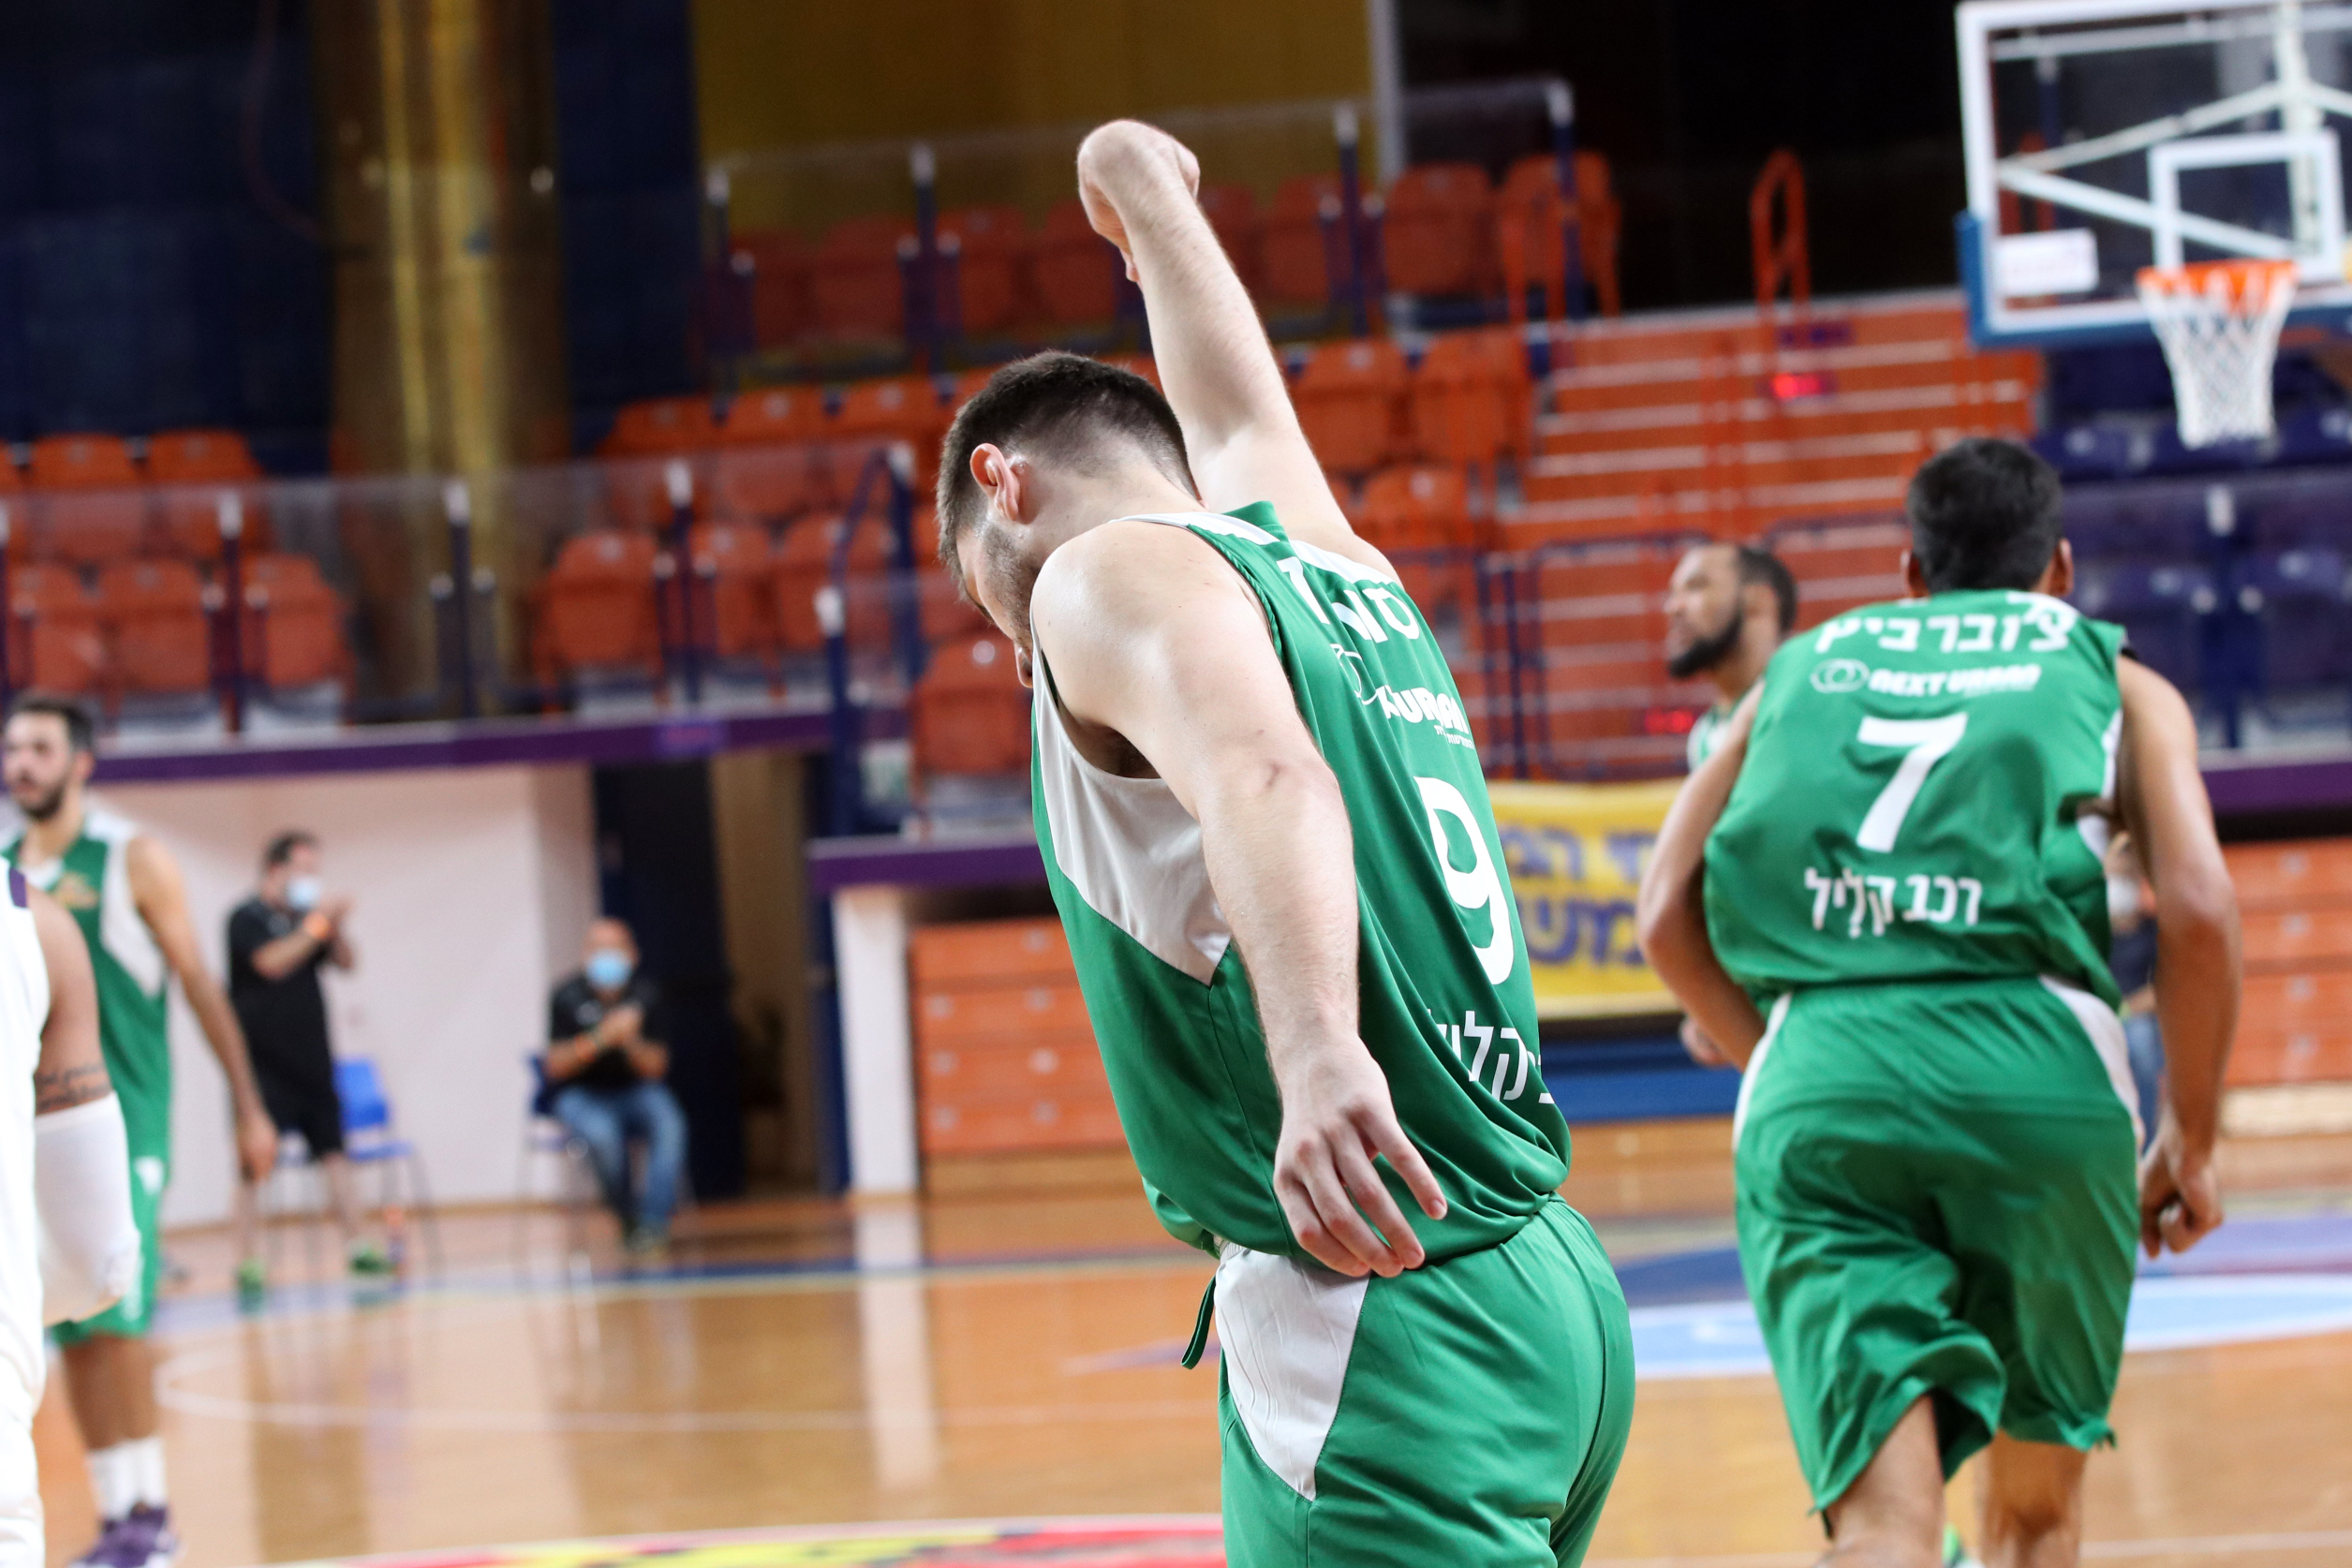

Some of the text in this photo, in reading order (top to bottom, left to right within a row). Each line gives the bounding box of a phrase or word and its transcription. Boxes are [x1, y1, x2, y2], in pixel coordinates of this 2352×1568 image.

[1856, 710, 1968, 853] 7
[1413, 777, 1514, 984] 9
[1902, 873, 1982, 926] רכב
